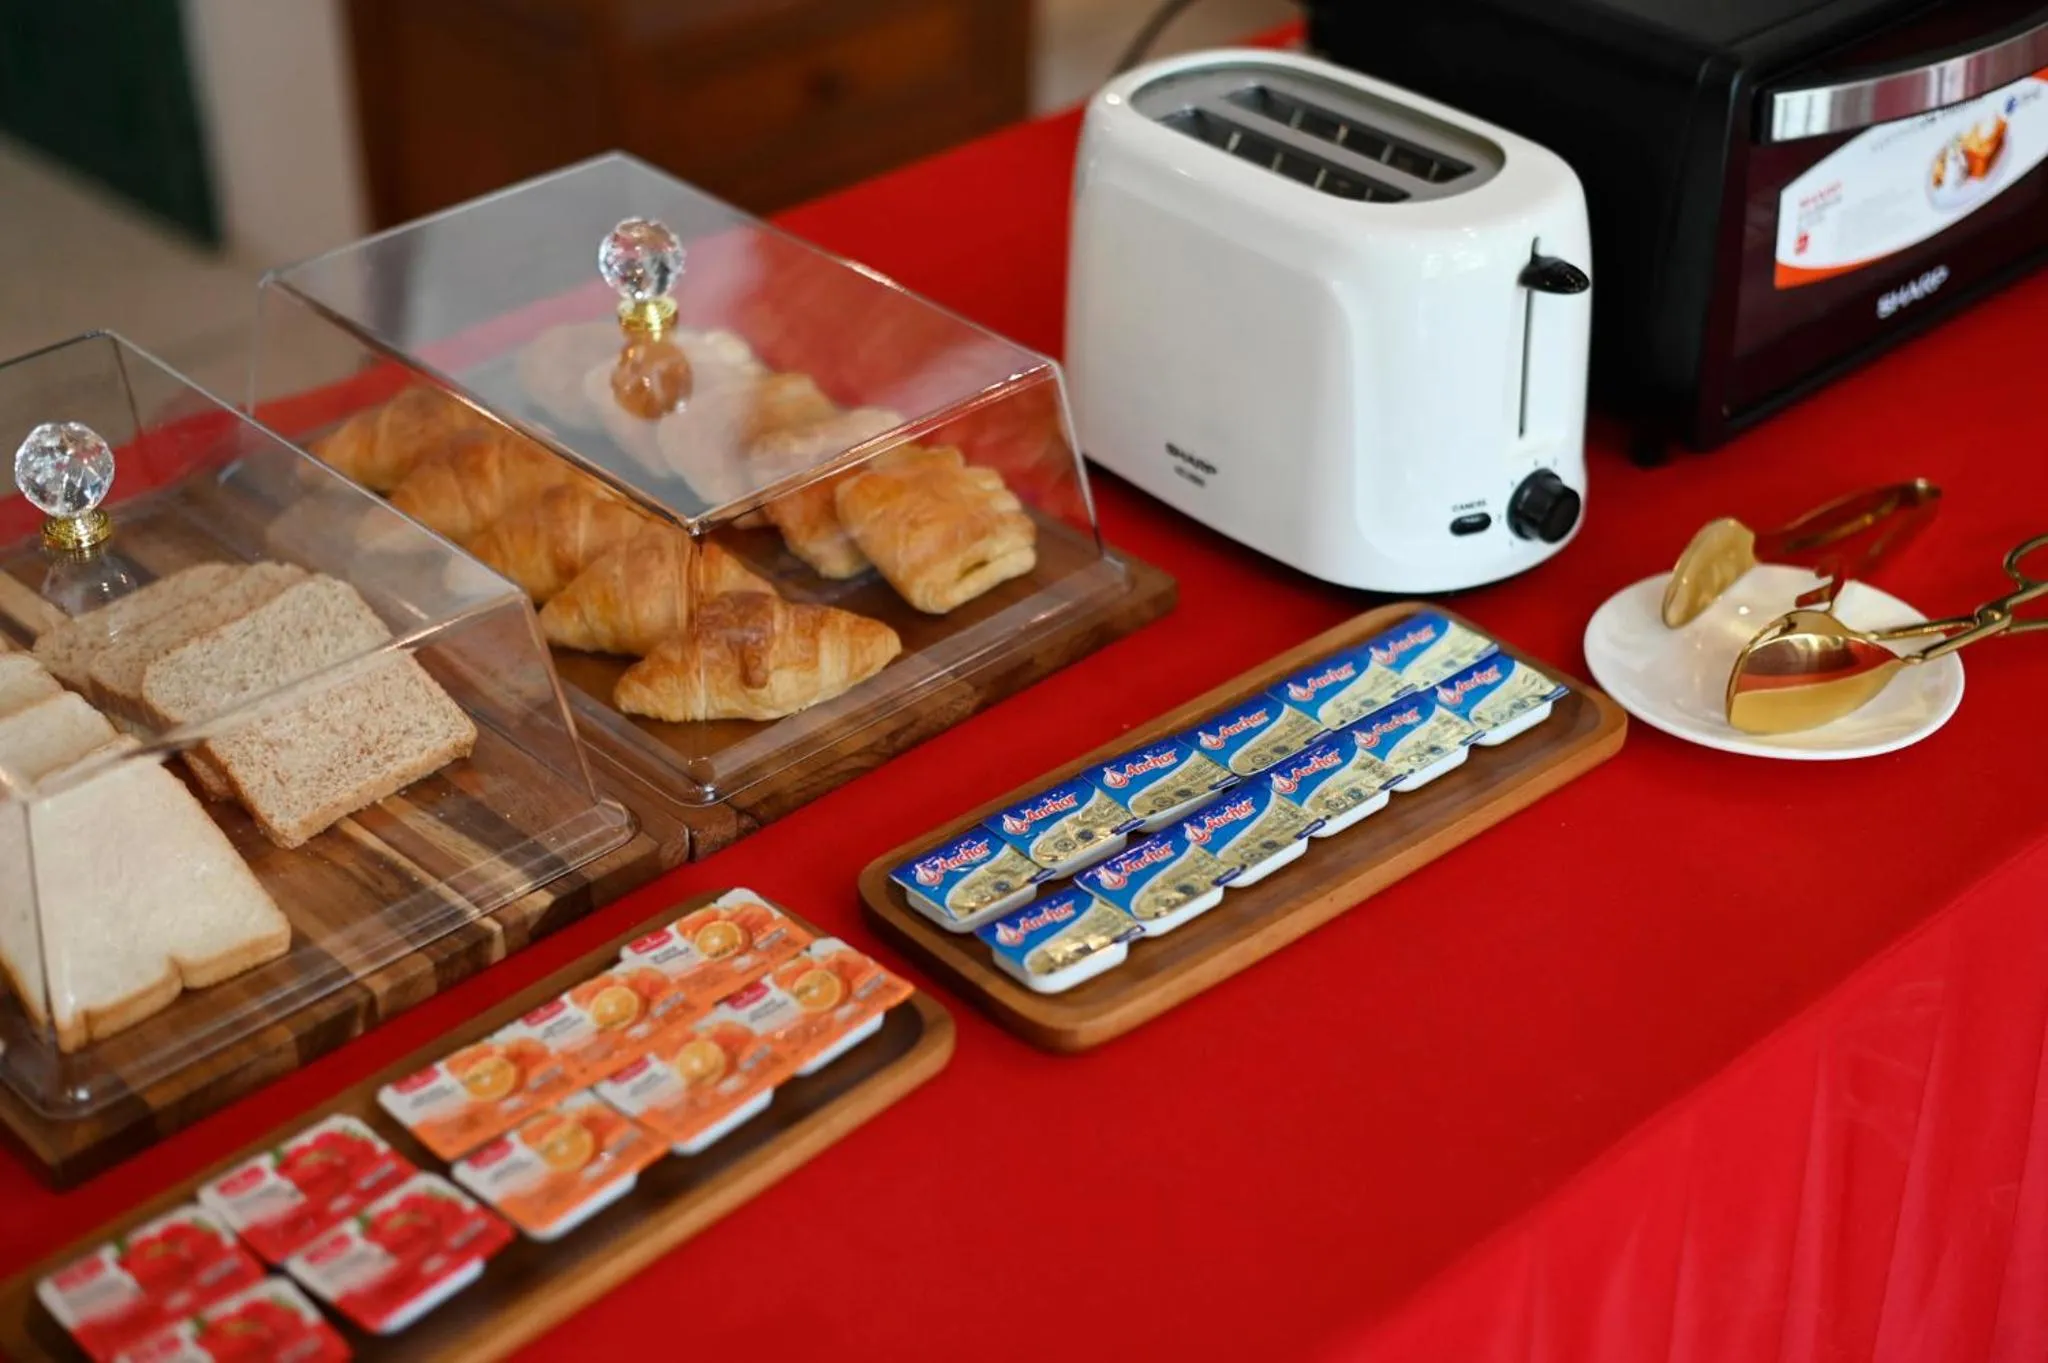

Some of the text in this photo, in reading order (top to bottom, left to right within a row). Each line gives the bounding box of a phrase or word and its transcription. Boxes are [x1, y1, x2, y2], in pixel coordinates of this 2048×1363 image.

[1308, 662, 1356, 692] Anchor
[1218, 709, 1269, 738] Anchor
[1126, 749, 1178, 777] Anchor
[1293, 749, 1342, 781] Anchor
[1023, 792, 1078, 825] Anchor
[1204, 797, 1256, 831] Anchor
[937, 840, 989, 872] Anchor
[1121, 841, 1175, 873] Anchor
[1019, 900, 1075, 933] Anchor
